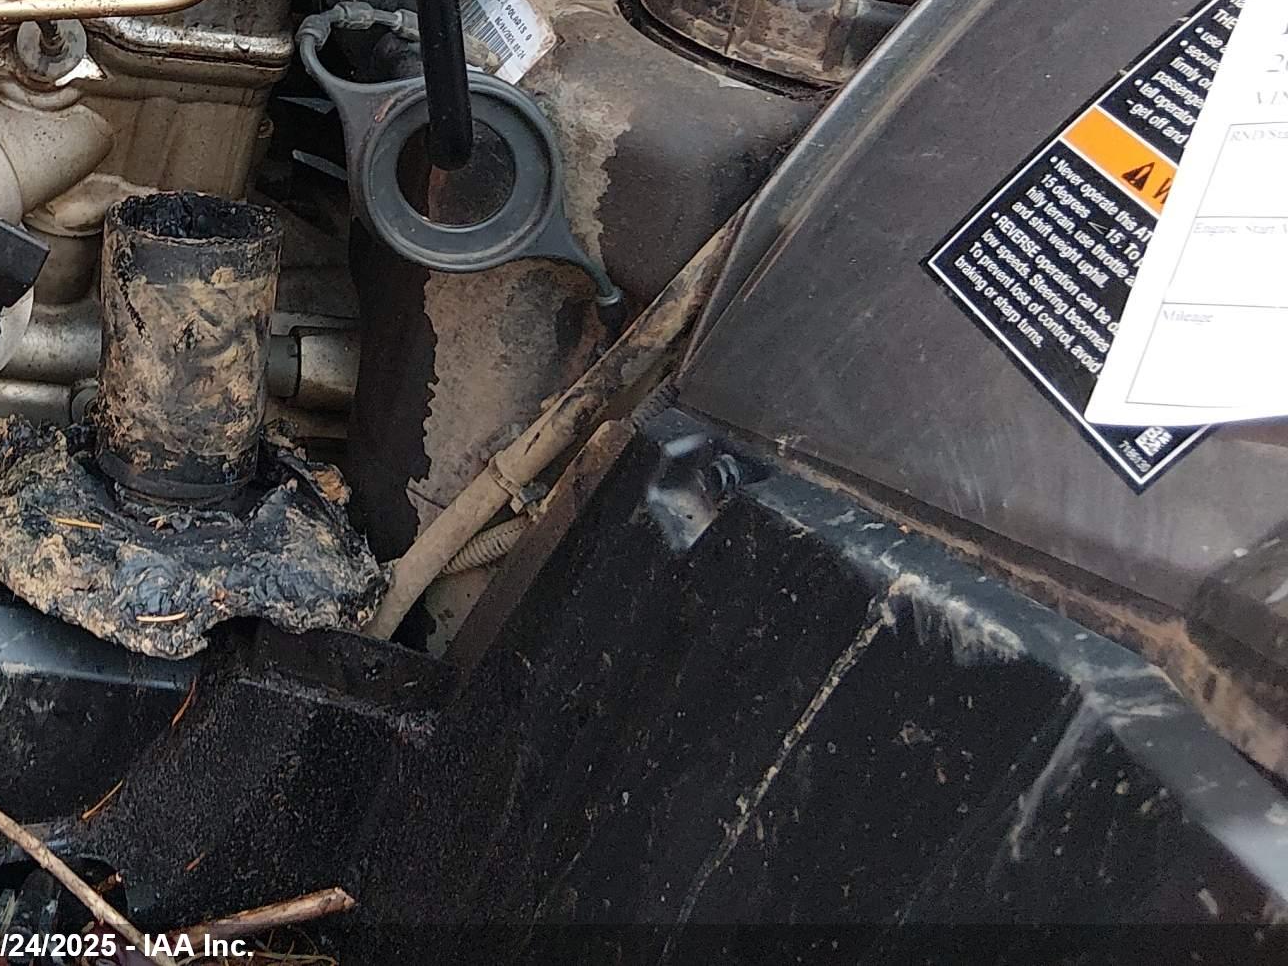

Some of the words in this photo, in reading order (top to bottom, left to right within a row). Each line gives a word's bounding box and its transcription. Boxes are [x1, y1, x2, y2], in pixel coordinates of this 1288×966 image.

[1170, 56, 1201, 82] firmly
[1200, 32, 1223, 48] use
[1129, 102, 1153, 121] get
[1149, 113, 1170, 130] off
[1163, 125, 1189, 145] and
[1139, 82, 1159, 99] tell
[1025, 186, 1047, 207] hilly
[1043, 202, 1076, 234] terrain,
[1074, 230, 1095, 249] use
[1091, 243, 1129, 278] throttle
[1040, 174, 1058, 188] 15
[1052, 185, 1091, 218] degrees
[1123, 243, 1141, 260] To
[1054, 159, 1084, 186] Never
[1080, 184, 1118, 215] operate
[1114, 207, 1137, 231] this
[1132, 226, 1154, 243] AT
[995, 215, 1042, 258] REVERSE
[1035, 254, 1080, 296] operation
[1076, 293, 1098, 312] can
[1093, 307, 1111, 325] be
[1012, 201, 1034, 220] and
[1028, 216, 1053, 237] shift
[1048, 232, 1082, 264] weight
[1076, 260, 1109, 288] uphill.
[954, 255, 988, 291] braking
[984, 287, 998, 299] or
[993, 295, 1022, 323] sharp
[1017, 318, 1044, 348] turns.
[969, 242, 983, 258] To
[977, 254, 1015, 289] prevent
[1010, 283, 1032, 305] loss
[1028, 301, 1044, 315] of
[1037, 313, 1075, 349] control,
[1071, 345, 1103, 373] avoid
[981, 229, 1000, 248] low
[996, 246, 1031, 279] speeds.
[1029, 274, 1068, 314] Steering
[1065, 308, 1110, 353] becomes
